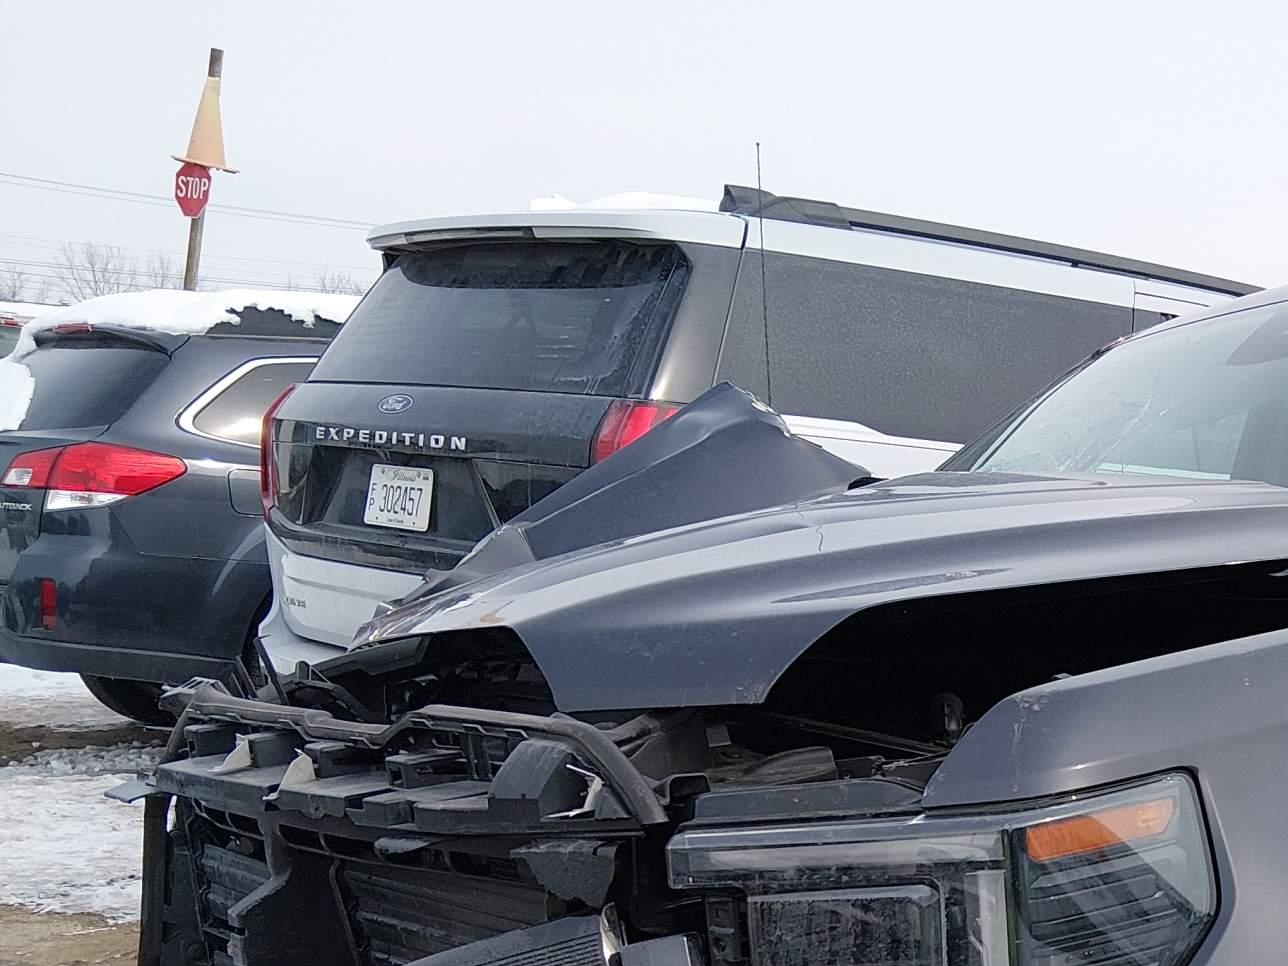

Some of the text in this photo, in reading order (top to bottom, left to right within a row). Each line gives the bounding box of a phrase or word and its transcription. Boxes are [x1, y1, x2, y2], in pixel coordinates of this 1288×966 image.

[177, 176, 209, 199] STOP
[316, 426, 467, 450] EXPEDITION
[379, 484, 423, 518] 302457
